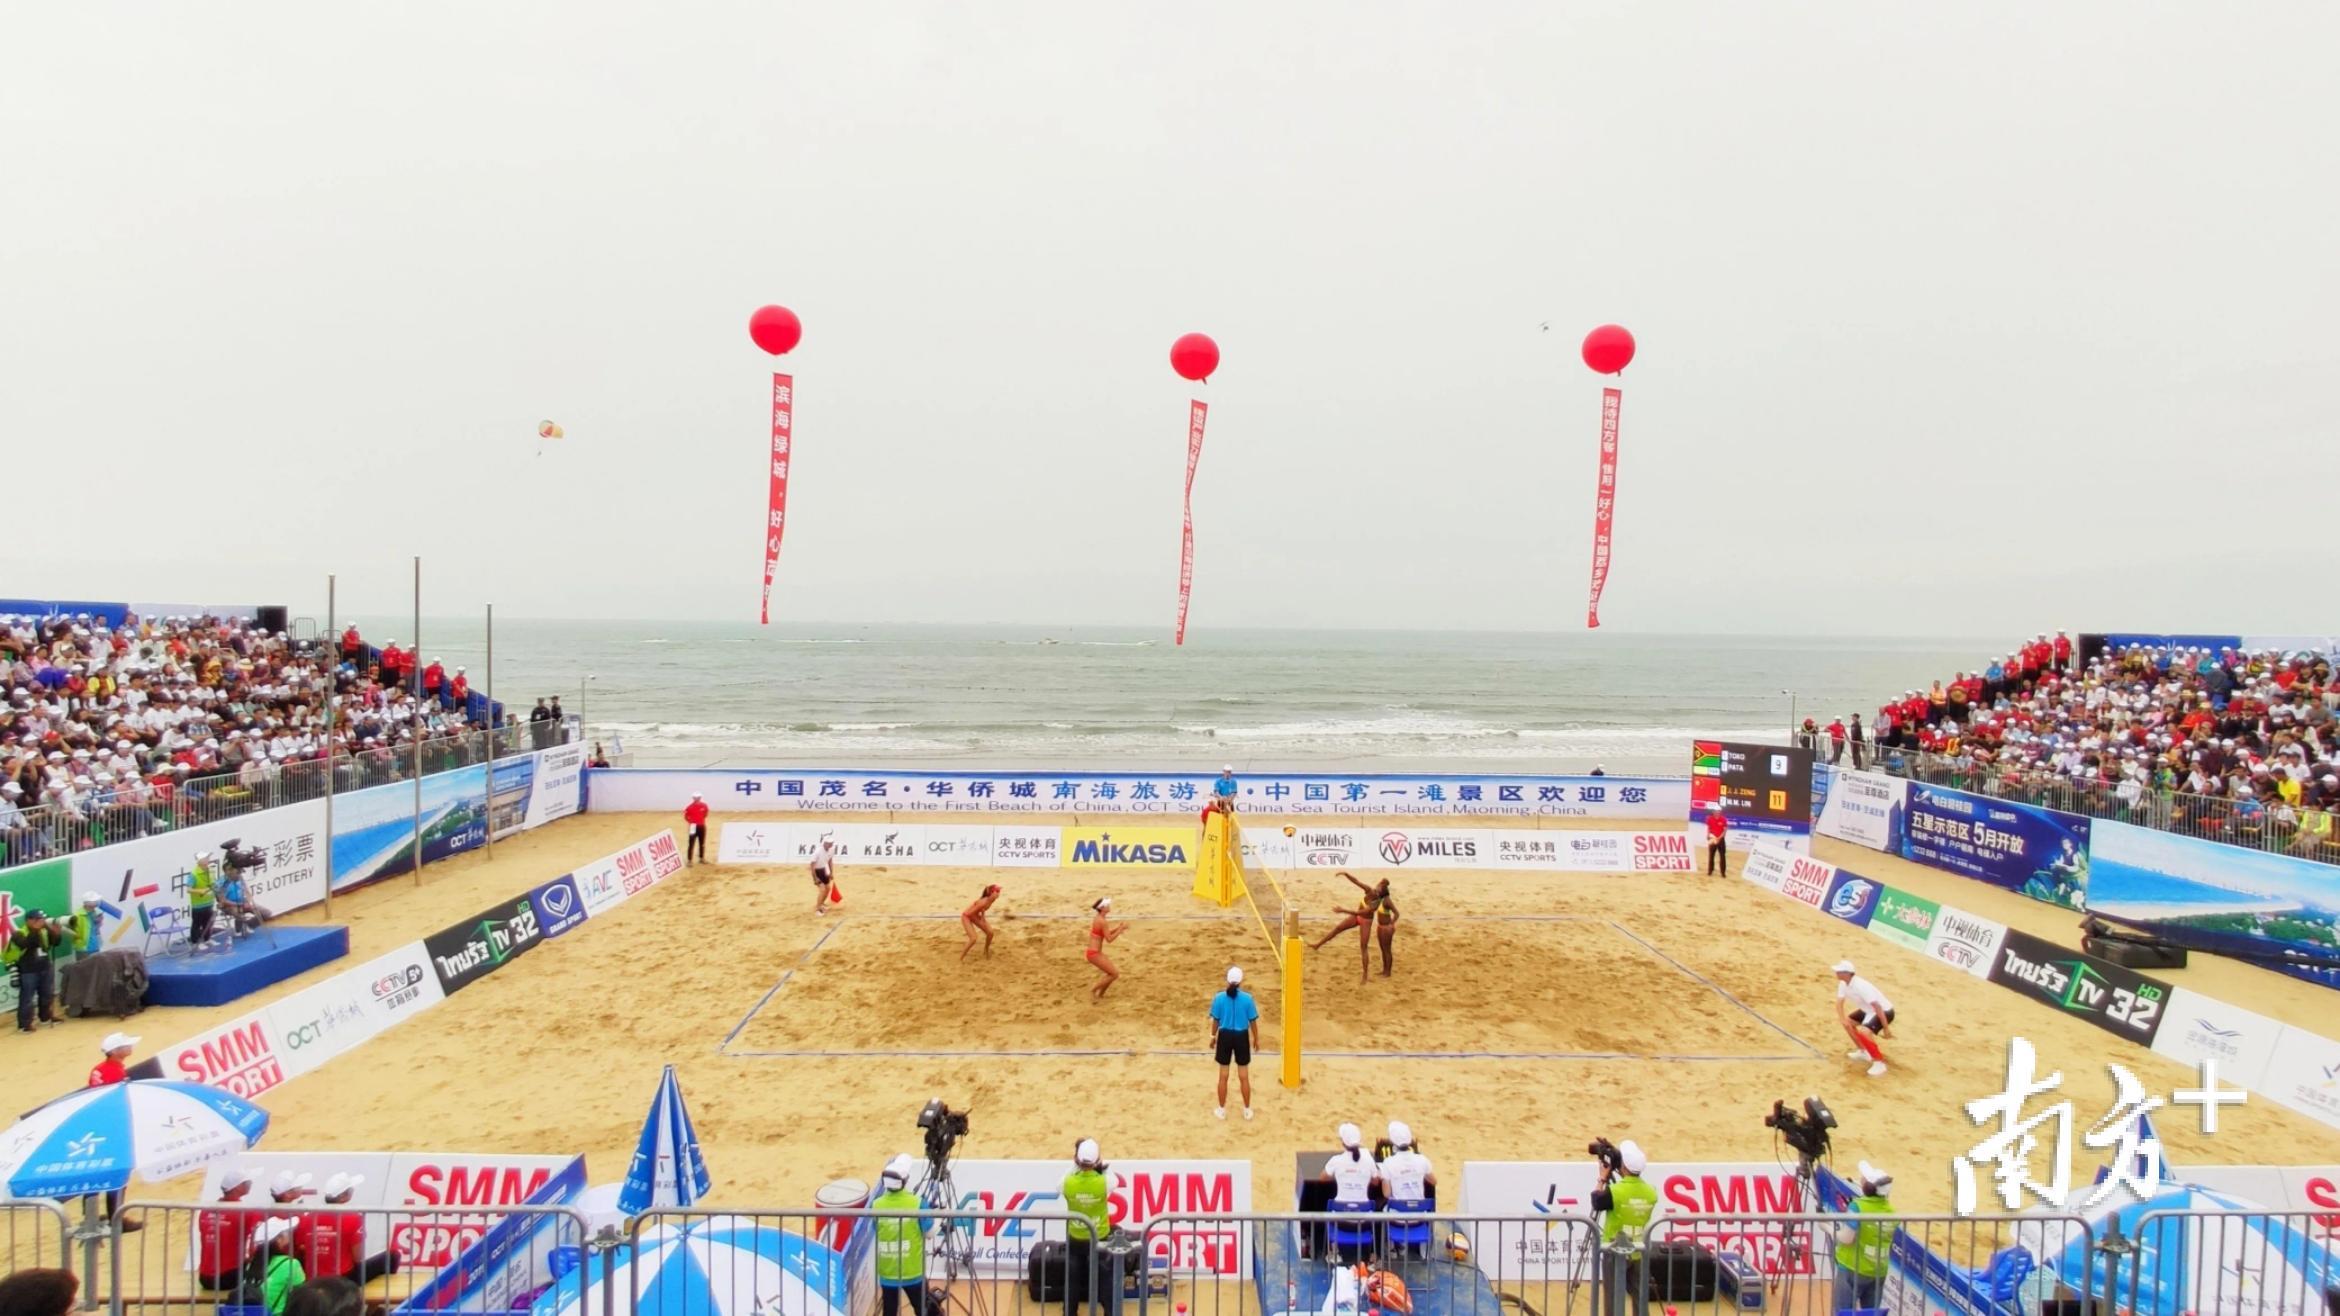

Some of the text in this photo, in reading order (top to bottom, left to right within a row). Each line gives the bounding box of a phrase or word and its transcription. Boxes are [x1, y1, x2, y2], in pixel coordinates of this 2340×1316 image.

[1776, 760, 1781, 770] 9
[798, 800, 878, 810] Welcome
[886, 801, 902, 810] to
[911, 801, 938, 810] the
[945, 801, 981, 811] First
[988, 801, 1041, 811] Beach
[1049, 801, 1068, 811] of
[1235, 802, 1283, 813] China
[1291, 803, 1322, 813] Sea
[1330, 802, 1386, 813] Tourist
[1540, 804, 1587, 815] China
[1772, 794, 1781, 806] 11
[1301, 833, 1353, 848] 中视体育
[1911, 810, 1970, 841] 五星示范区
[1973, 821, 2025, 856] 5月开放
[647, 835, 676, 862] SMM
[864, 845, 914, 857] KASHA
[928, 841, 955, 852] OCT
[999, 838, 1056, 849] 央视体育
[1417, 841, 1477, 857] MILES
[1499, 841, 1556, 853] 央视体育
[1634, 835, 1688, 854] SMM
[616, 847, 646, 877] SMM
[998, 851, 1056, 859] CCTV SPORTS
[1307, 852, 1349, 866] CCTV
[1500, 854, 1557, 862] CCTV SPORTS
[1635, 856, 1690, 870] SPORT
[655, 855, 684, 879] SPORT
[1790, 858, 1829, 888] SMM
[266, 866, 315, 893] LOTTERY
[624, 871, 654, 896] SPORT
[1784, 878, 1822, 906] SPORT
[493, 927, 511, 951] TV
[509, 909, 540, 943] 32
[549, 919, 567, 935] GRAND
[1943, 914, 1994, 949] 中视体育
[1937, 941, 1982, 969] CCTV
[2137, 983, 2162, 1002] HD
[2077, 977, 2105, 1006] TV
[2105, 987, 2159, 1031] 32
[287, 1019, 323, 1051] OCT
[177, 1019, 271, 1084] SMM
[1663, 1174, 1805, 1226] SMM
